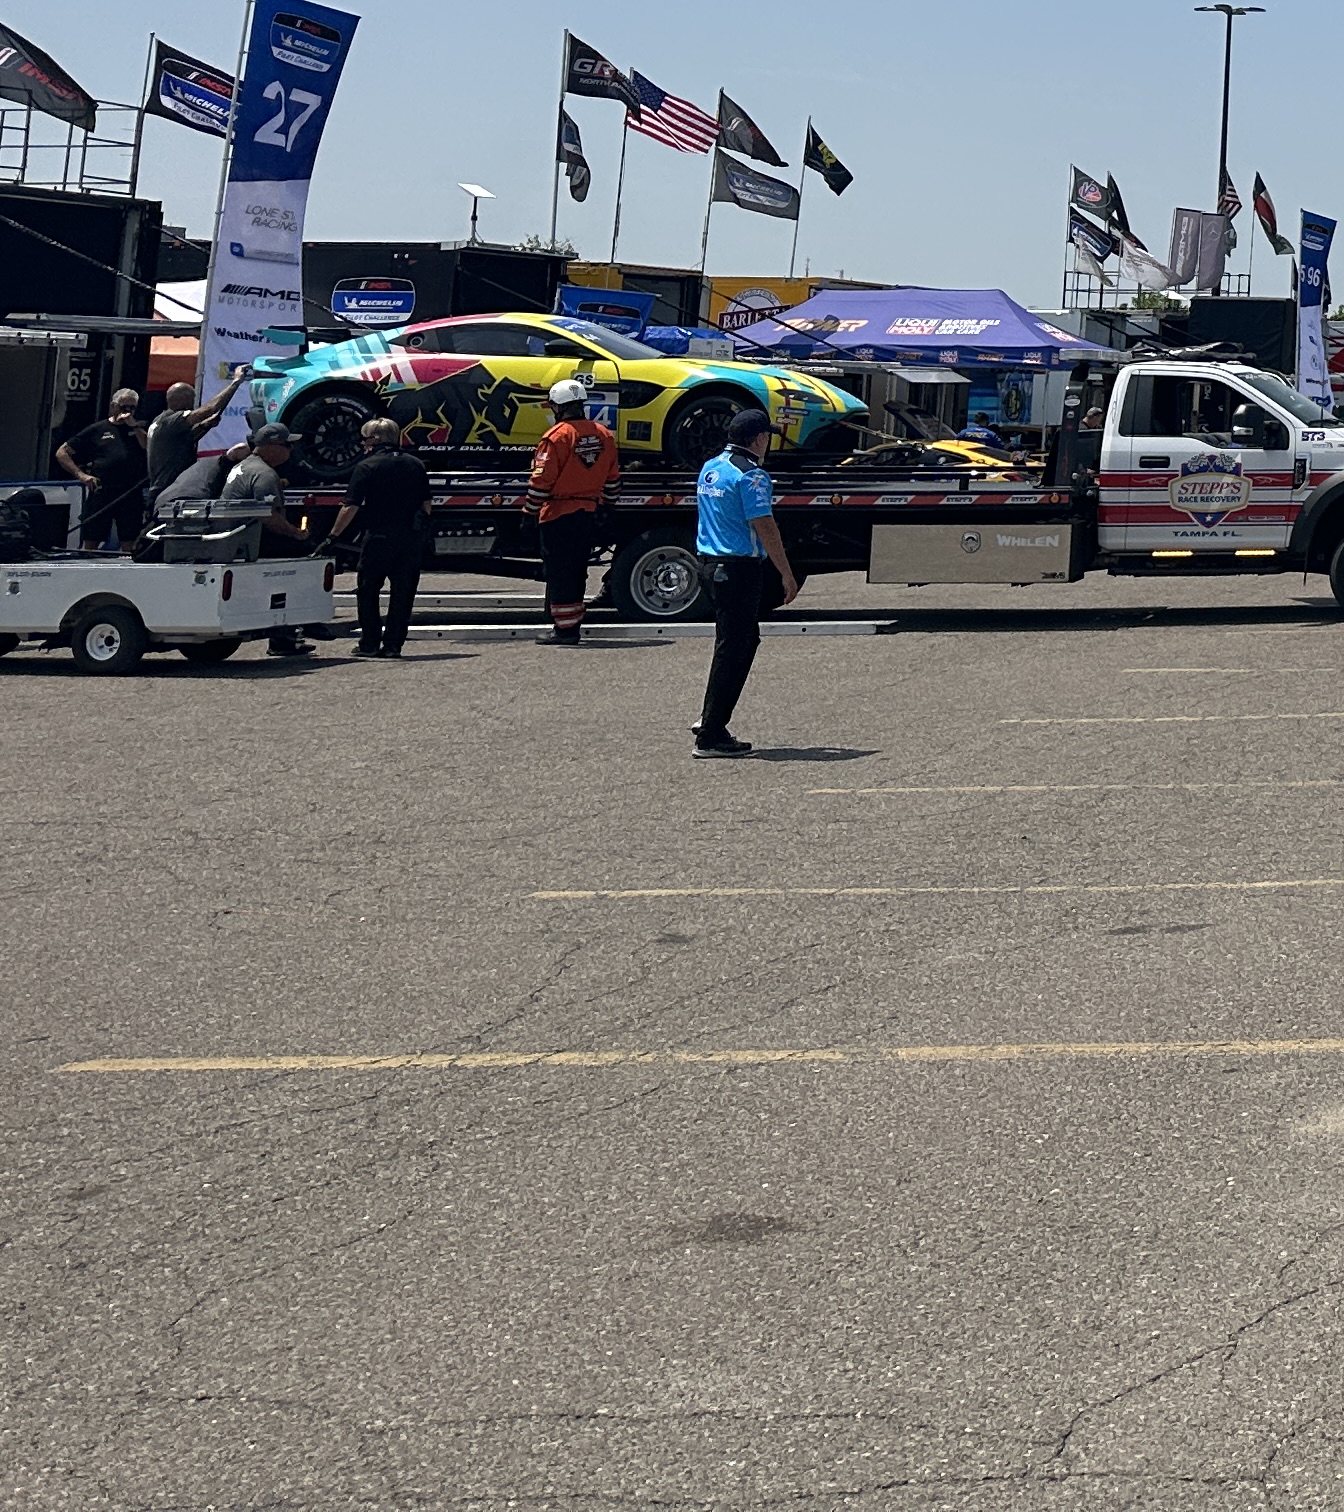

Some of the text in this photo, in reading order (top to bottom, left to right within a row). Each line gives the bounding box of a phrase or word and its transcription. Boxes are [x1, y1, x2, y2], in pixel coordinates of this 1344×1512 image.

[254, 80, 323, 153] 27
[245, 203, 280, 219] LONE
[251, 216, 298, 233] RACING
[217, 295, 298, 313] MOTORSPOR
[889, 325, 935, 335] MOLY
[894, 318, 939, 327] LIQUI
[67, 367, 92, 391] 65
[573, 374, 594, 386] GS
[1178, 481, 1242, 495] STEPP'S
[1200, 495, 1242, 503] RECOVERY
[996, 533, 1060, 548] WHELEN
